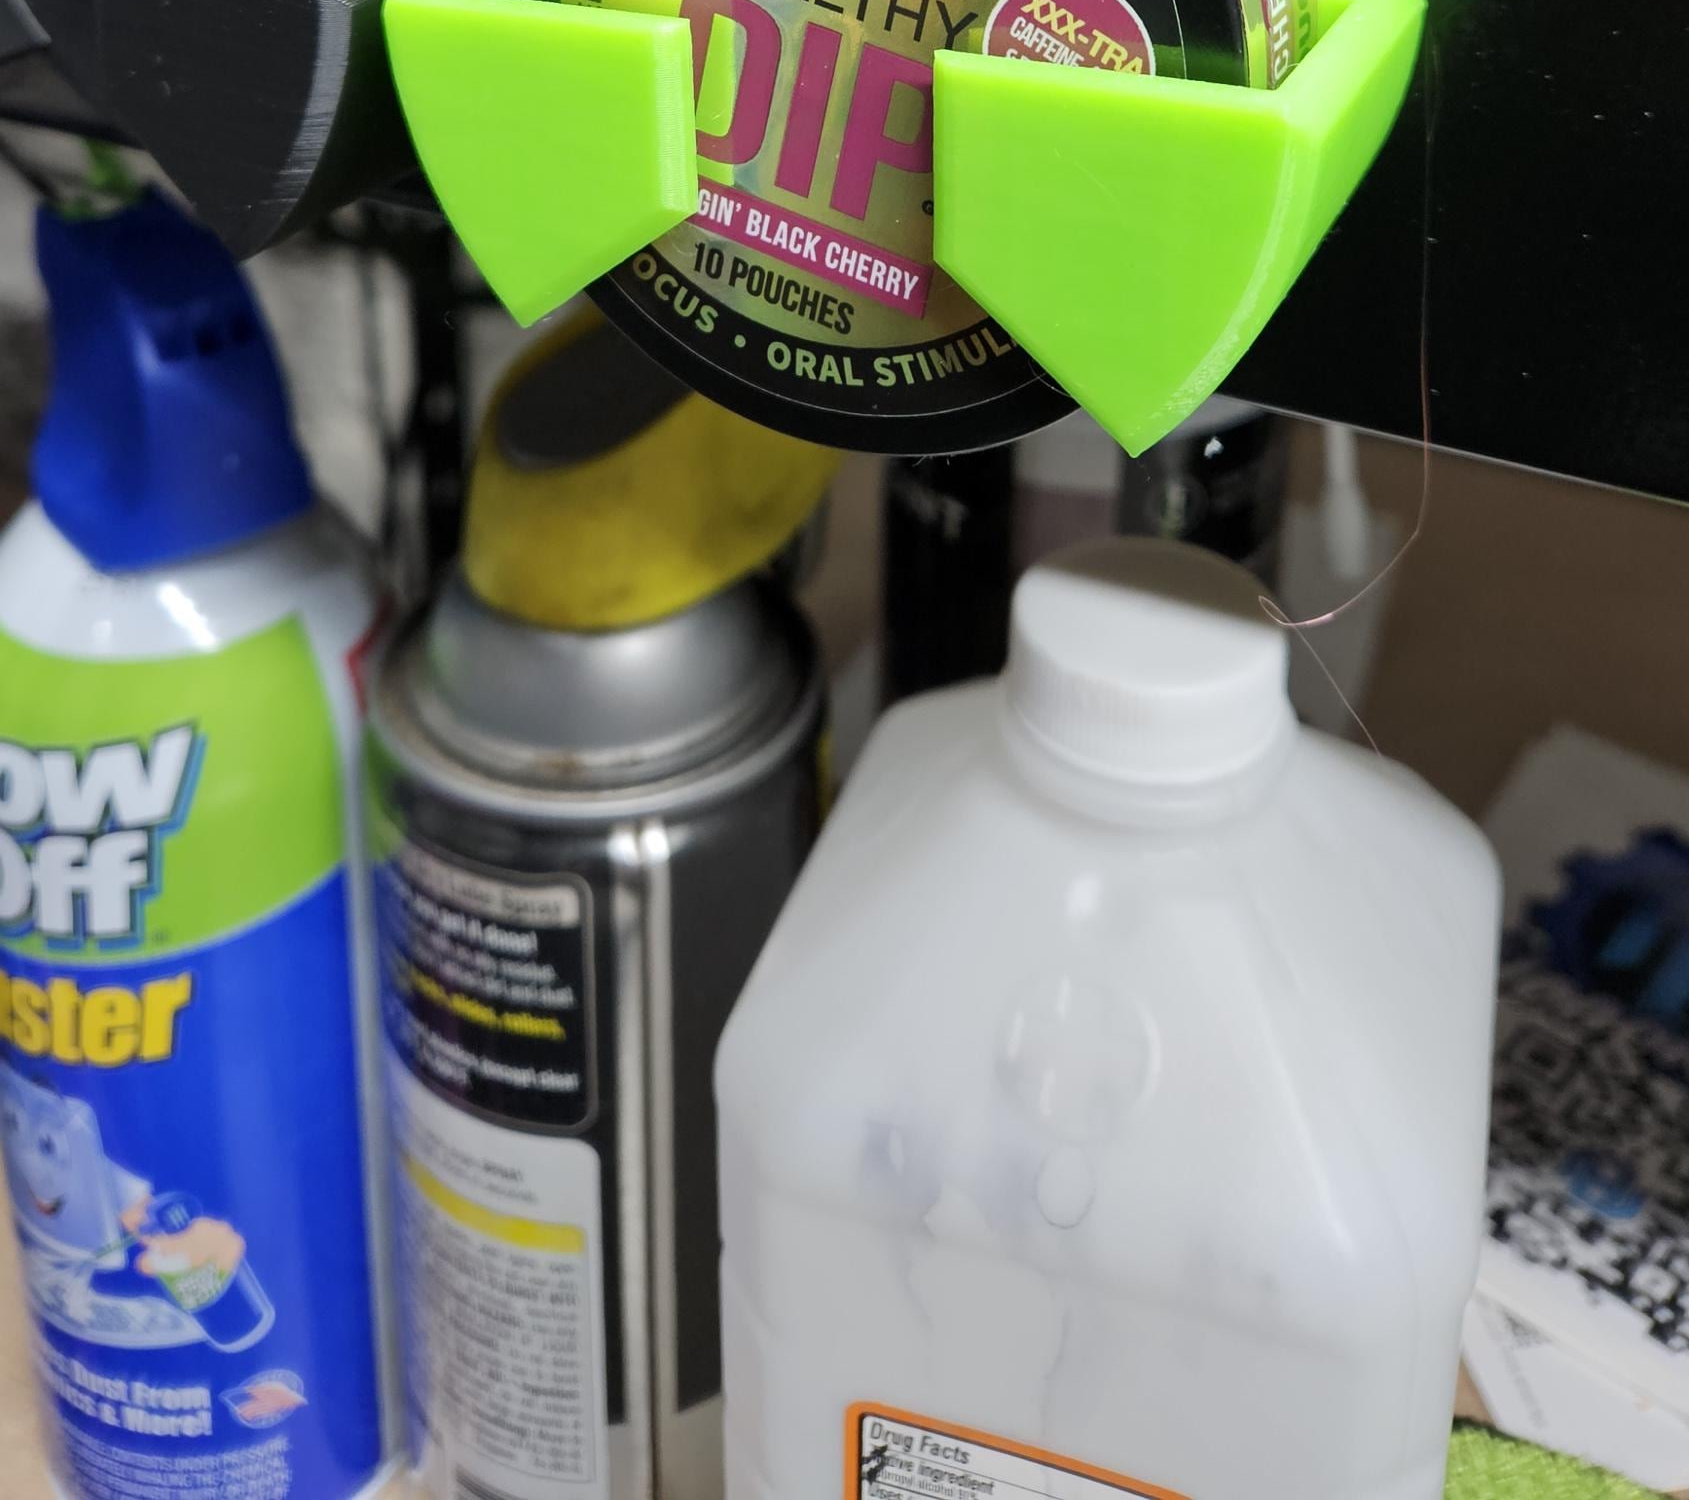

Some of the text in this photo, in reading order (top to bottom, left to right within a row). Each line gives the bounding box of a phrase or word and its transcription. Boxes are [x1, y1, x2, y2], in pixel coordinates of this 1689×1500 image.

[692, 242, 856, 336] 10 POUCHES
[745, 207, 823, 263] BLACK
[824, 240, 920, 300] CHERRY
[766, 340, 864, 387] ORAL
[873, 326, 1018, 387] STIMUL
[870, 1421, 971, 1465] Drug Facts
